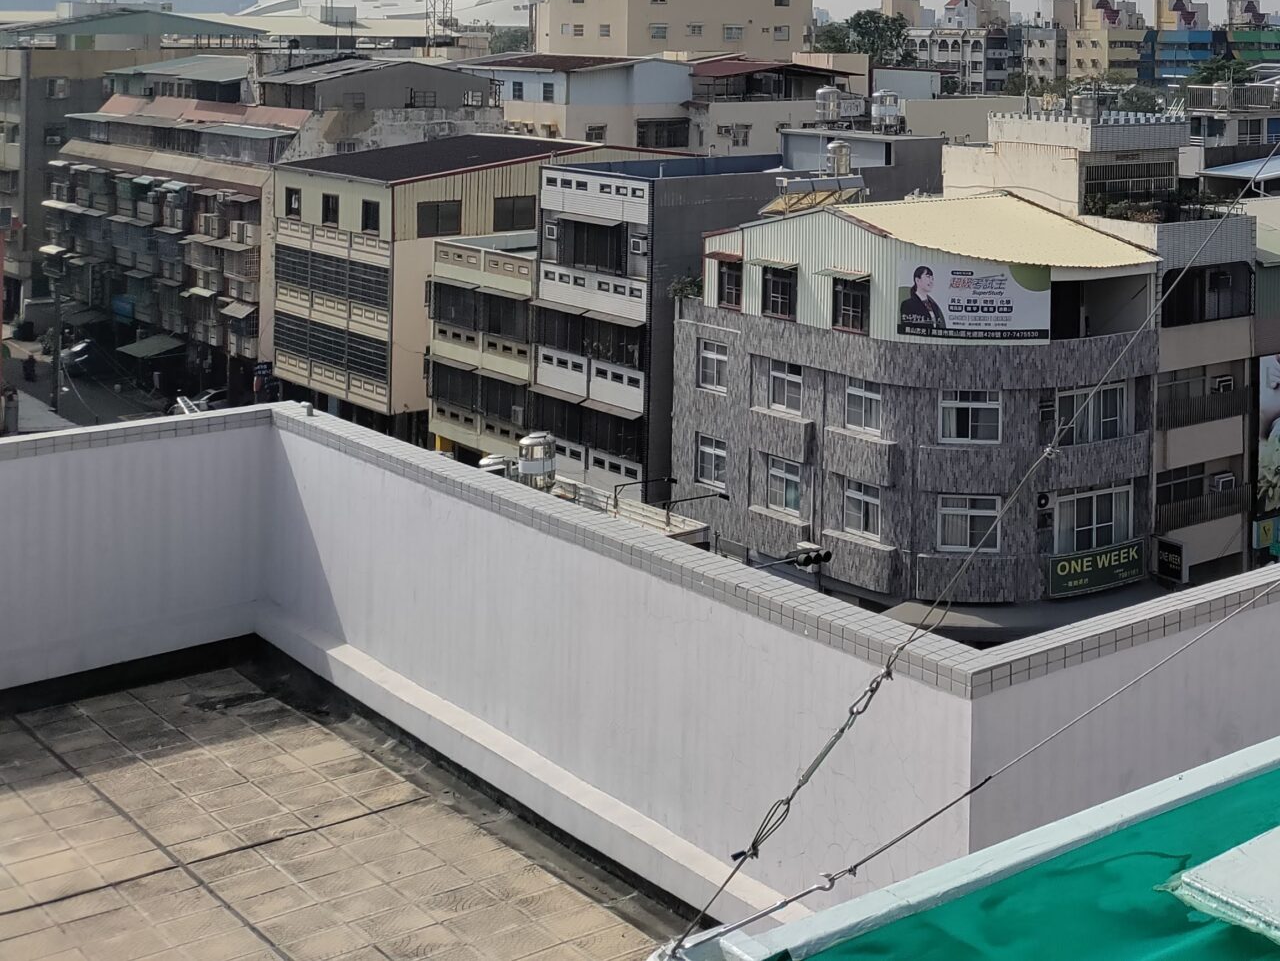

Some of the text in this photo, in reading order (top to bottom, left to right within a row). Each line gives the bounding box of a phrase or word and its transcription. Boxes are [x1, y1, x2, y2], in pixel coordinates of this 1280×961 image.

[972, 289, 1004, 297] SuperStudy
[1057, 545, 1139, 576] ONE WEEK
